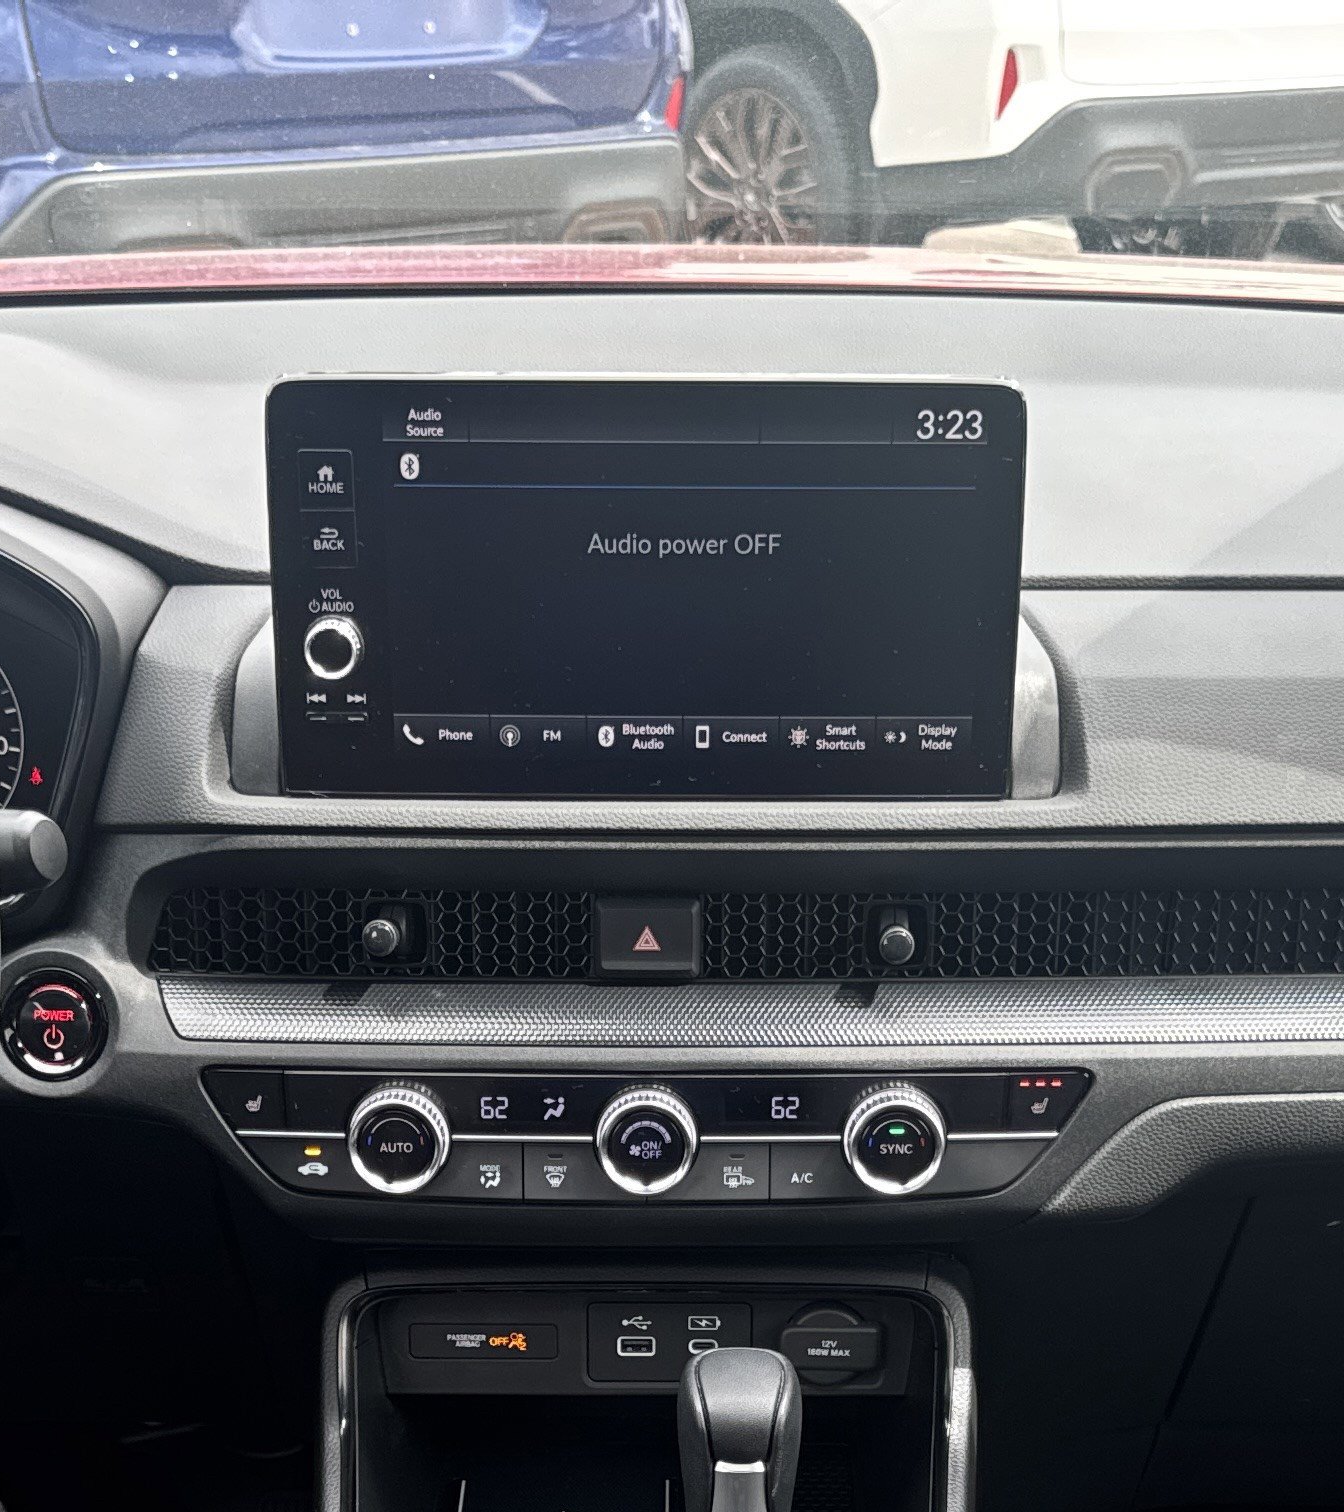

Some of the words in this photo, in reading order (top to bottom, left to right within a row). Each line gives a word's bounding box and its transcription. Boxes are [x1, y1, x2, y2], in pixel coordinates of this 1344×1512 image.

[407, 407, 442, 421] Audio
[406, 424, 444, 437] Source
[916, 410, 983, 440] 3:23
[308, 482, 345, 494] HOME
[313, 539, 346, 551] BACK
[587, 533, 652, 555] Audio
[658, 537, 728, 559] power
[734, 534, 782, 555] OFF
[320, 588, 343, 600] VOL
[321, 601, 355, 612] AUDIO
[437, 728, 474, 741] Phone
[621, 723, 675, 736] Bluetooth
[825, 723, 857, 736] Smart
[917, 723, 958, 738] Display
[542, 730, 562, 742] FM
[722, 730, 768, 743] Connect
[631, 738, 665, 750] Audio
[815, 738, 866, 751] Shortcuts
[920, 738, 953, 751] Mode
[34, 1009, 75, 1021] POWER
[480, 1096, 508, 1119] 62
[771, 1096, 800, 1119] 62
[379, 1142, 414, 1153] AUTO
[878, 1143, 914, 1155] SYNC
[641, 1150, 663, 1160] OFF
[543, 1165, 568, 1173] FRONT
[790, 1172, 814, 1184] A/C
[489, 1337, 509, 1346] OFF
[821, 1340, 838, 1348] 12V
[830, 1349, 851, 1357] MAX
